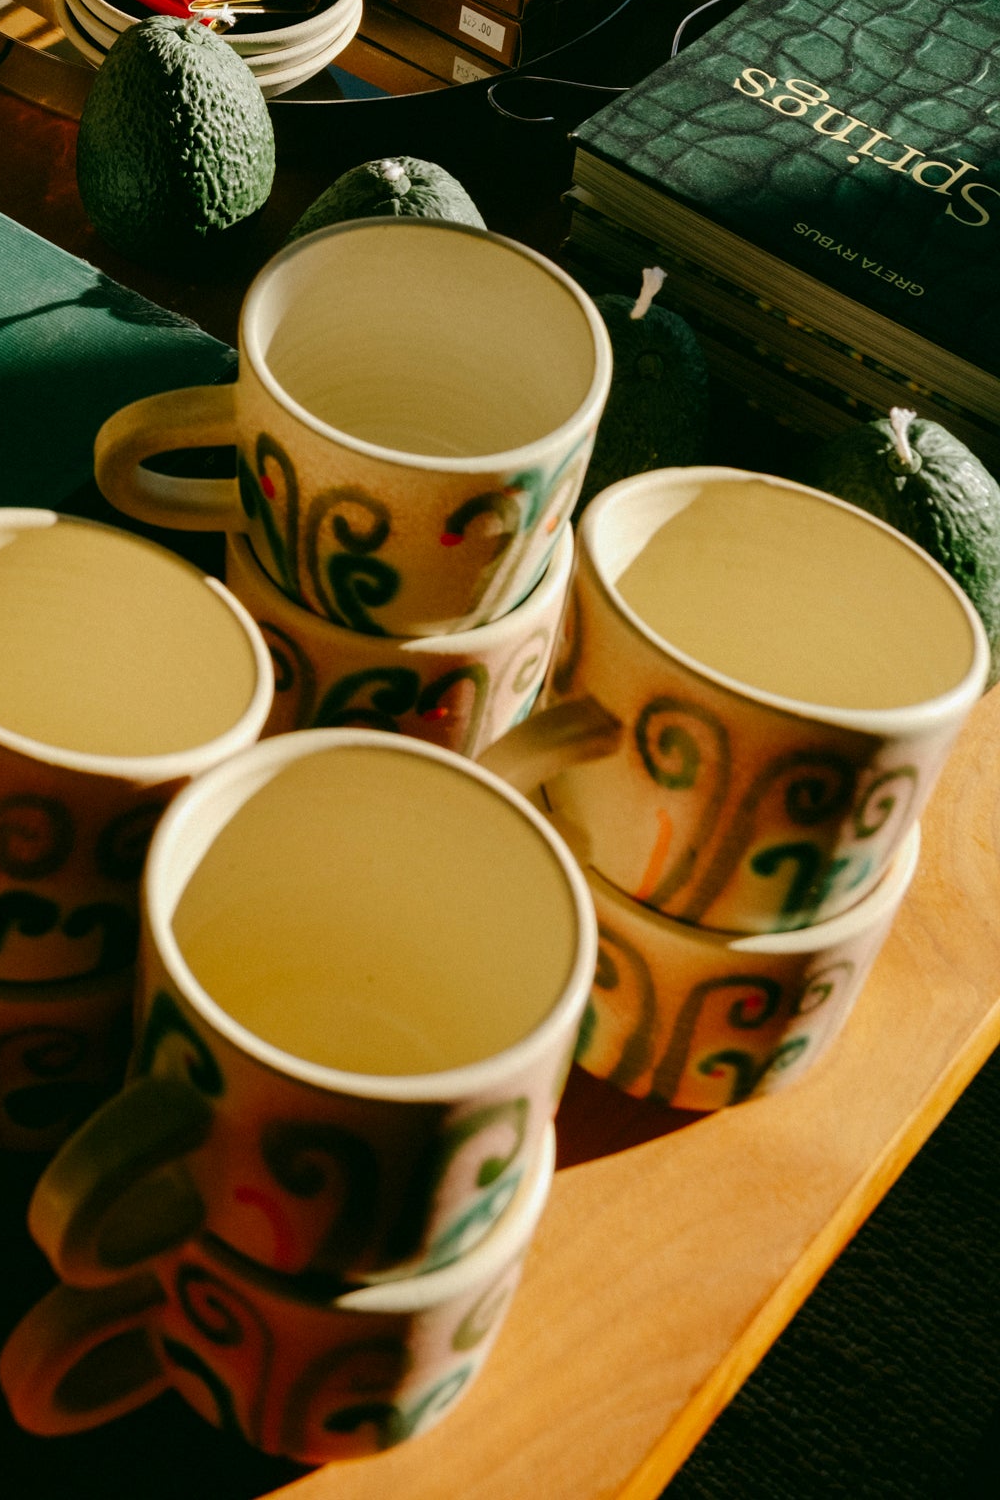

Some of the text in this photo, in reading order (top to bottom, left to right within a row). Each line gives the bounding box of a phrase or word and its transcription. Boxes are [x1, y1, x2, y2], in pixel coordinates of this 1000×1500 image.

[462, 13, 492, 37] $25.00
[733, 67, 1000, 227] Springs
[792, 222, 925, 297] GRETA RYBUS
